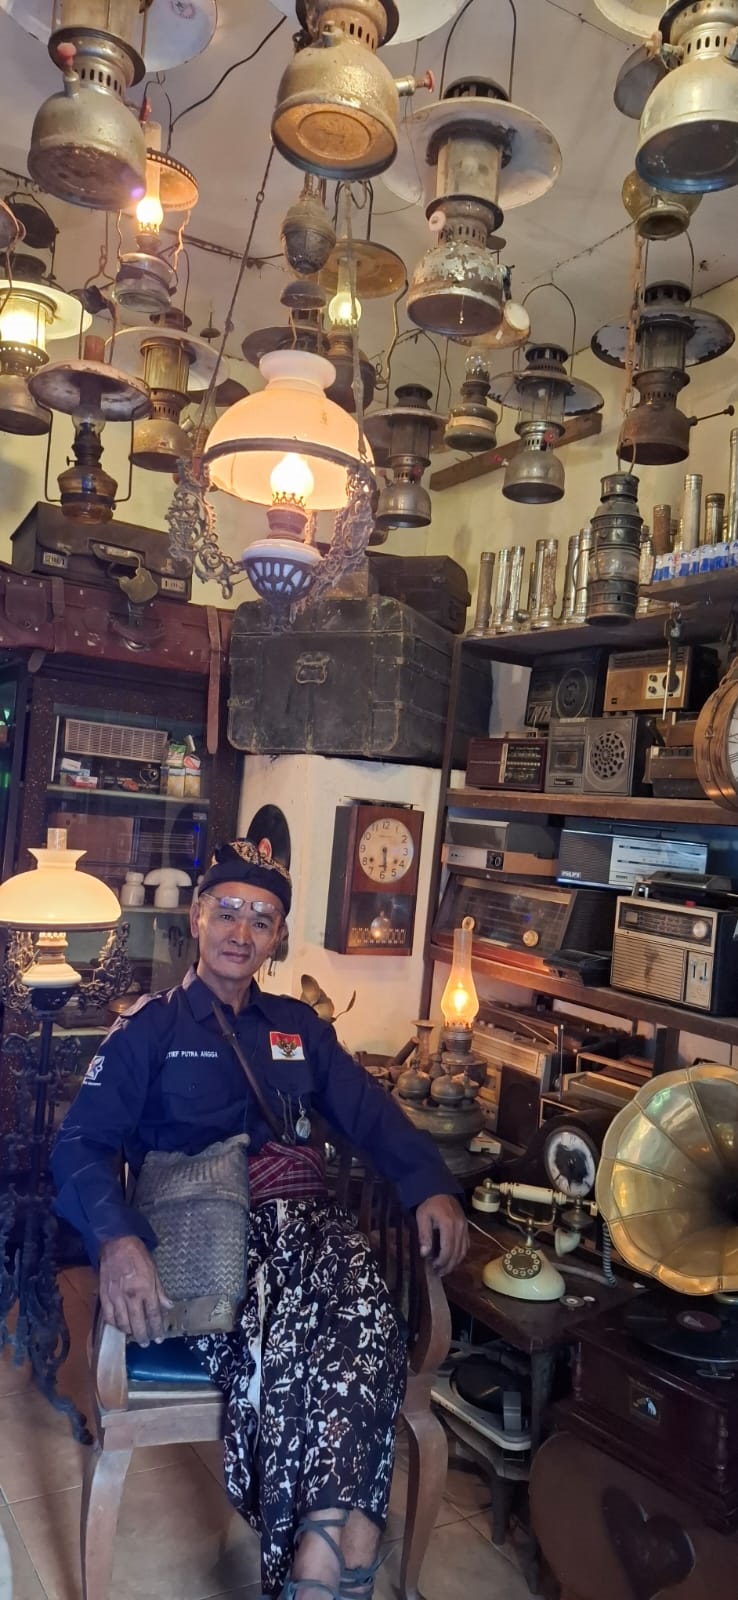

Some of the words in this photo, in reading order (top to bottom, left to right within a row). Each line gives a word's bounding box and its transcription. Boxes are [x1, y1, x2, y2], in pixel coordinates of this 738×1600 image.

[382, 820, 390, 830] 12
[363, 831, 371, 841] 10
[401, 834, 407, 844] 2
[360, 844, 366, 853] 9
[402, 847, 409, 856] 3
[362, 856, 368, 866] 8
[398, 860, 405, 868] 4
[379, 870, 385, 880] 6
[391, 868, 397, 877] 5
[181, 1050, 199, 1058] PUTRA
